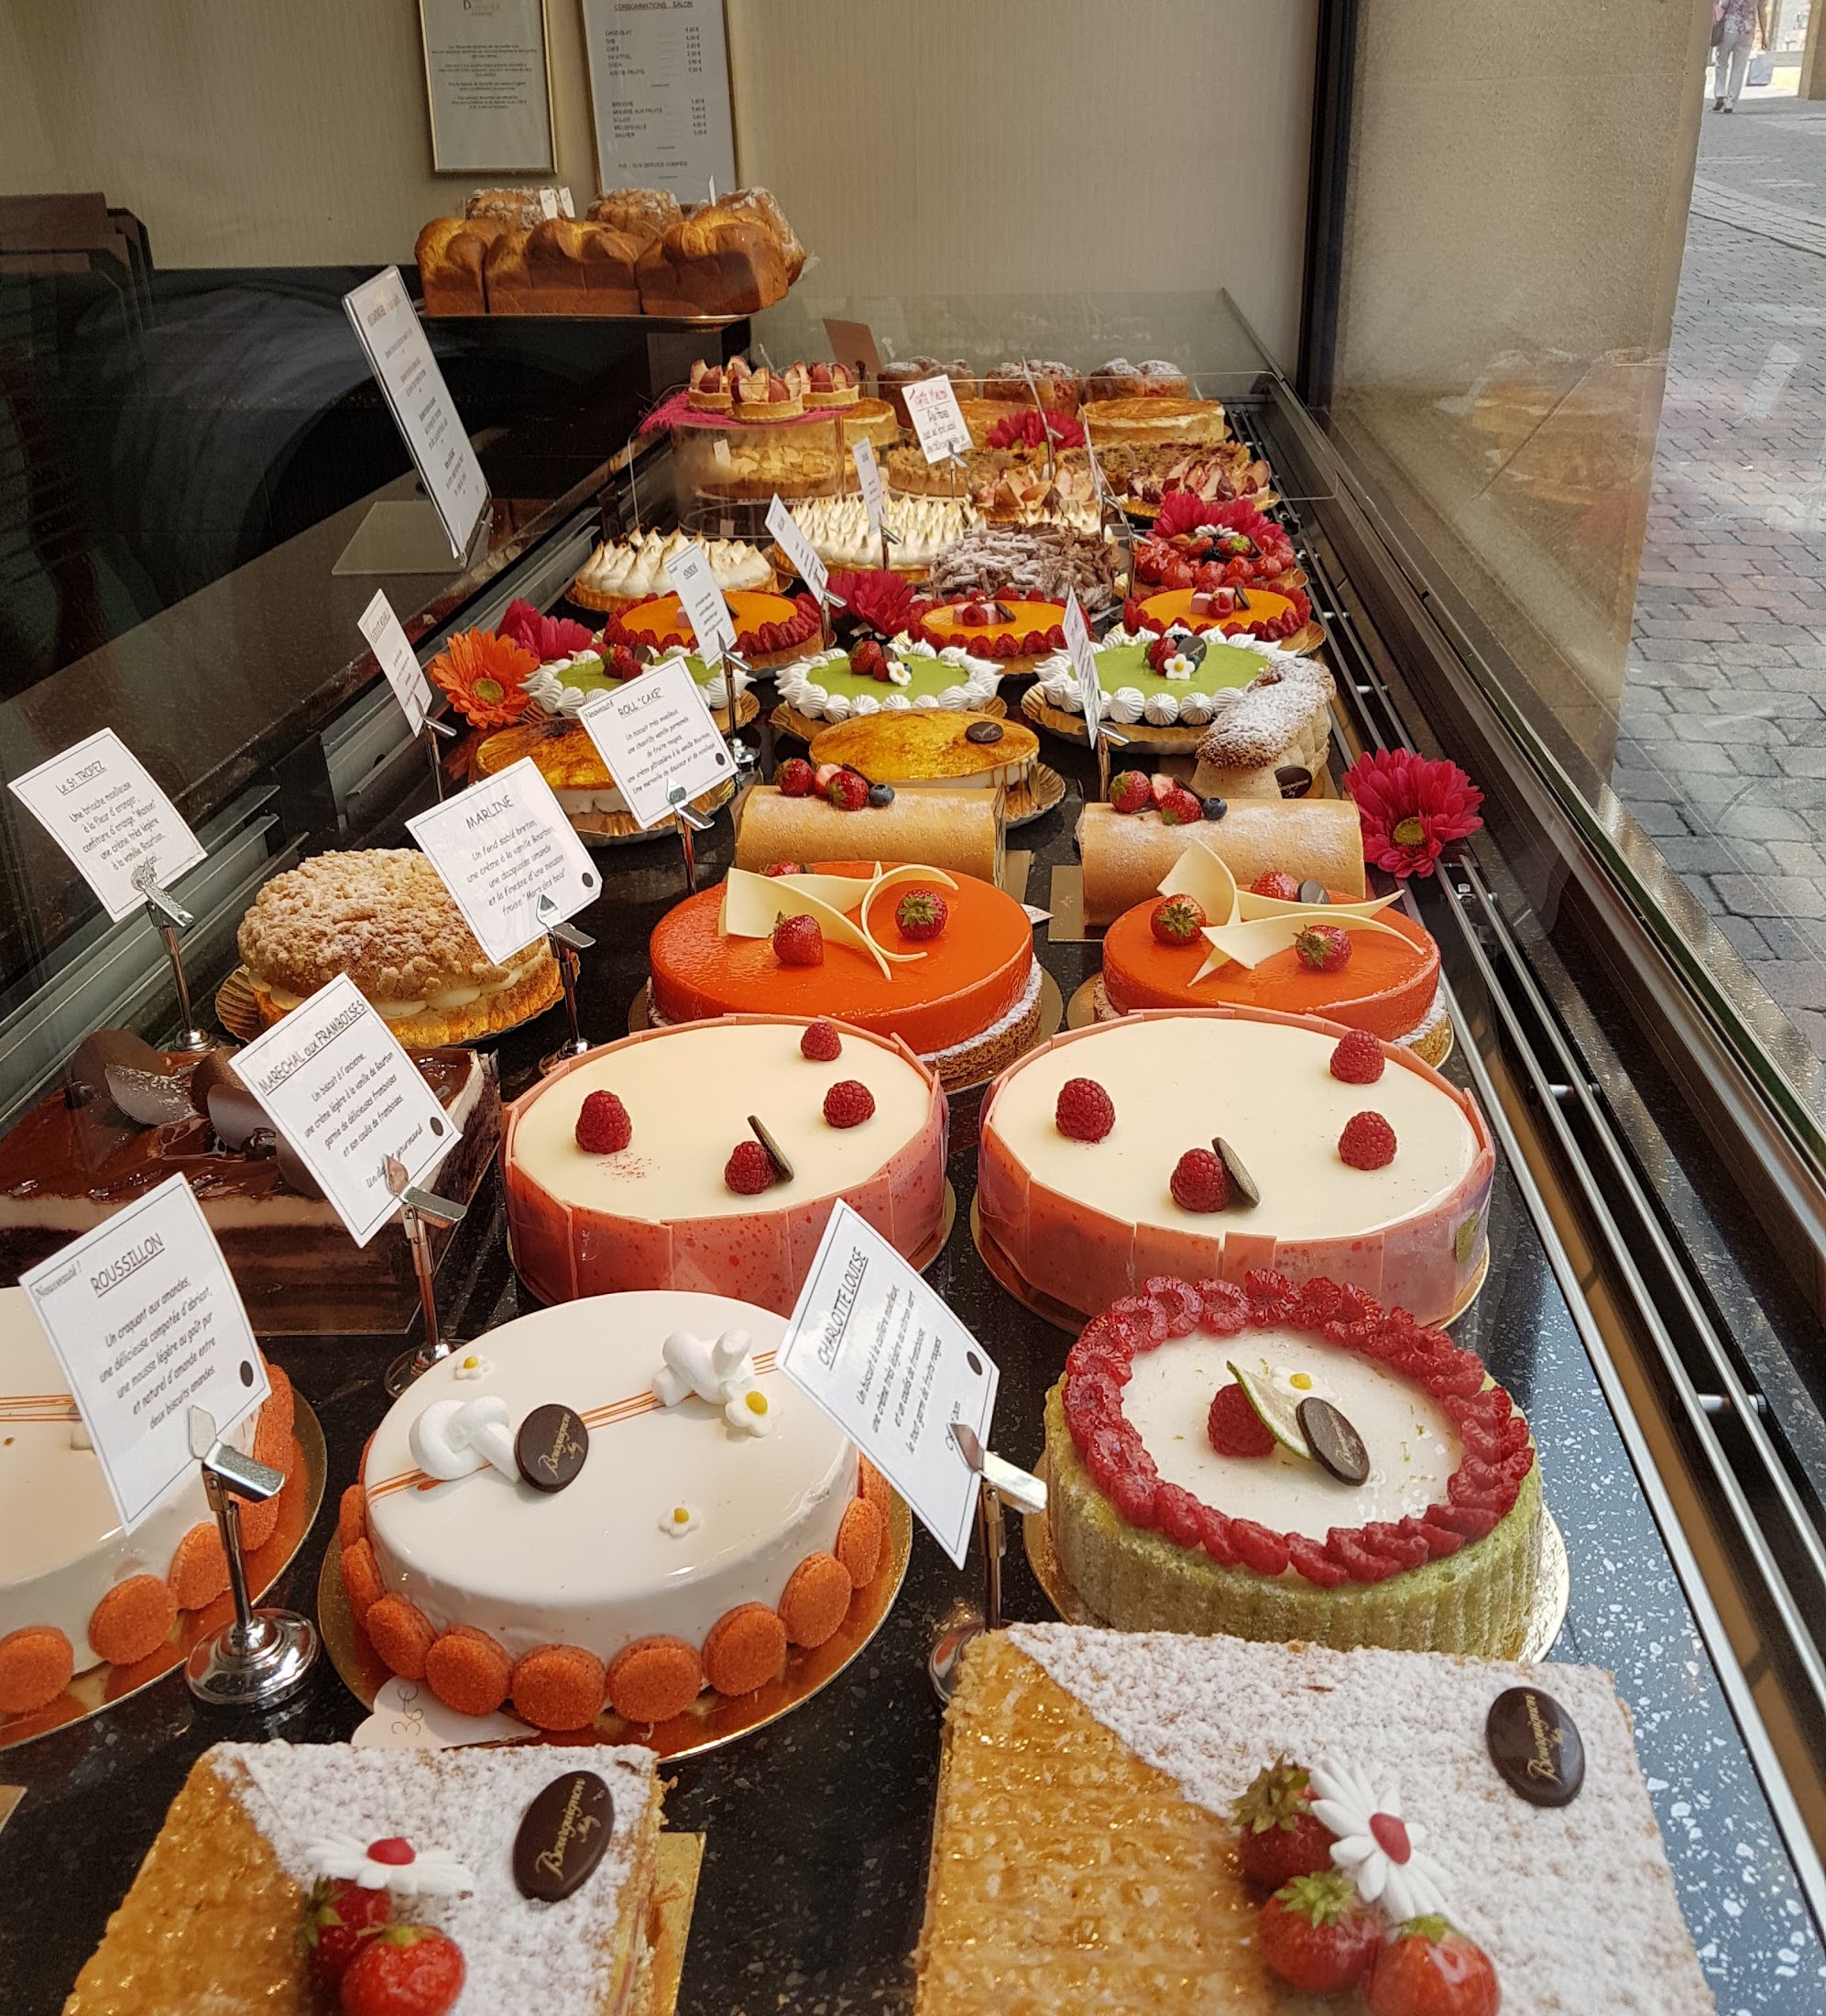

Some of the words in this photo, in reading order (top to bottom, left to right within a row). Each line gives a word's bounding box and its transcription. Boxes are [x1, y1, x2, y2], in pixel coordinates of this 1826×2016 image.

[618, 702, 639, 717] ROLL
[55, 783, 69, 794] Le
[66, 777, 78, 788] St
[74, 760, 105, 781] TROPEZ
[68, 811, 84, 823] Une
[81, 797, 106, 815] brioche
[104, 782, 132, 801] moelleuse
[465, 794, 513, 828] MARLINE
[82, 831, 111, 853] confiture
[109, 816, 135, 835] d'orange
[86, 821, 96, 830] la
[100, 849, 113, 860] une
[111, 837, 130, 853] crème
[127, 827, 142, 840] très
[139, 817, 159, 832] légère
[115, 859, 125, 867] la
[123, 848, 142, 862] vanille
[466, 871, 478, 883] une
[479, 859, 499, 875] crème
[505, 850, 513, 860] la
[513, 839, 531, 854] vanille
[471, 851, 482, 861] Un
[482, 838, 498, 855] fond
[498, 828, 516, 846] sablé
[488, 877, 500, 888] une
[530, 844, 552, 861] amande
[488, 896, 496, 906] et
[496, 892, 504, 901] la
[504, 878, 528, 896] finesse
[544, 854, 564, 871] mousse
[502, 899, 522, 915] fraise
[541, 879, 552, 891] des
[257, 1052, 305, 1093] MARECHAL
[303, 1040, 319, 1057] aux
[315, 1000, 365, 1045] FRAMBOISES
[304, 1124, 315, 1138] une
[314, 1110, 332, 1128] crème
[329, 1095, 347, 1112] légère
[348, 1086, 356, 1095] la
[355, 1073, 370, 1090] vanille
[369, 1068, 377, 1077] de
[374, 1052, 393, 1071] Bourbon
[311, 1091, 322, 1101] Un
[319, 1076, 337, 1095] biscuit
[324, 1128, 342, 1150] garnie
[340, 1121, 349, 1132] de
[347, 1097, 373, 1124] délicieuses
[372, 1074, 397, 1101] framboises
[343, 1145, 350, 1157] et
[349, 1138, 359, 1151] son
[358, 1124, 373, 1142] coulis
[372, 1118, 379, 1128] de
[91, 1233, 162, 1292] ROUSSILLON
[104, 1333, 117, 1347] Un
[117, 1308, 147, 1339] craquant
[148, 1299, 160, 1315] aux
[161, 1276, 191, 1304] amandes,
[818, 1288, 851, 1364] CHARLOTTE
[842, 1246, 866, 1295] LOUISE
[907, 1289, 915, 1309] vert
[876, 1317, 889, 1347] cuillère
[897, 1331, 905, 1343] au
[900, 1308, 911, 1333] citron
[99, 1366, 114, 1383] une
[114, 1337, 148, 1371] délicieuse
[149, 1310, 180, 1342] compotée
[116, 1382, 130, 1398] une
[131, 1360, 157, 1386] mousse
[156, 1342, 178, 1364] légère
[179, 1334, 187, 1346] au
[187, 1320, 201, 1343] goût
[202, 1311, 213, 1331] pur
[870, 1345, 880, 1355] la
[888, 1341, 902, 1369] légère
[133, 1400, 140, 1415] et
[142, 1375, 167, 1407] naturel
[167, 1353, 197, 1384] d'amande
[198, 1337, 215, 1357] entre
[859, 1359, 874, 1392] biscuit
[883, 1365, 894, 1387] très
[906, 1366, 914, 1380] de
[922, 1361, 935, 1389] fruits
[856, 1389, 866, 1405] Un
[877, 1386, 889, 1415] crème
[901, 1376, 912, 1404] coulis
[920, 1386, 929, 1401] de
[149, 1409, 165, 1430] deux
[165, 1387, 190, 1415] biscuits
[872, 1413, 880, 1433] une
[894, 1411, 902, 1428] et
[898, 1402, 904, 1416] un
[916, 1396, 925, 1428] garni
[538, 1412, 571, 1480] Bourguignon
[905, 1441, 914, 1454] le
[910, 1419, 919, 1443] tout
[1524, 1693, 1562, 1786] Bourguignon
[535, 1777, 586, 1882] Bourguignon
